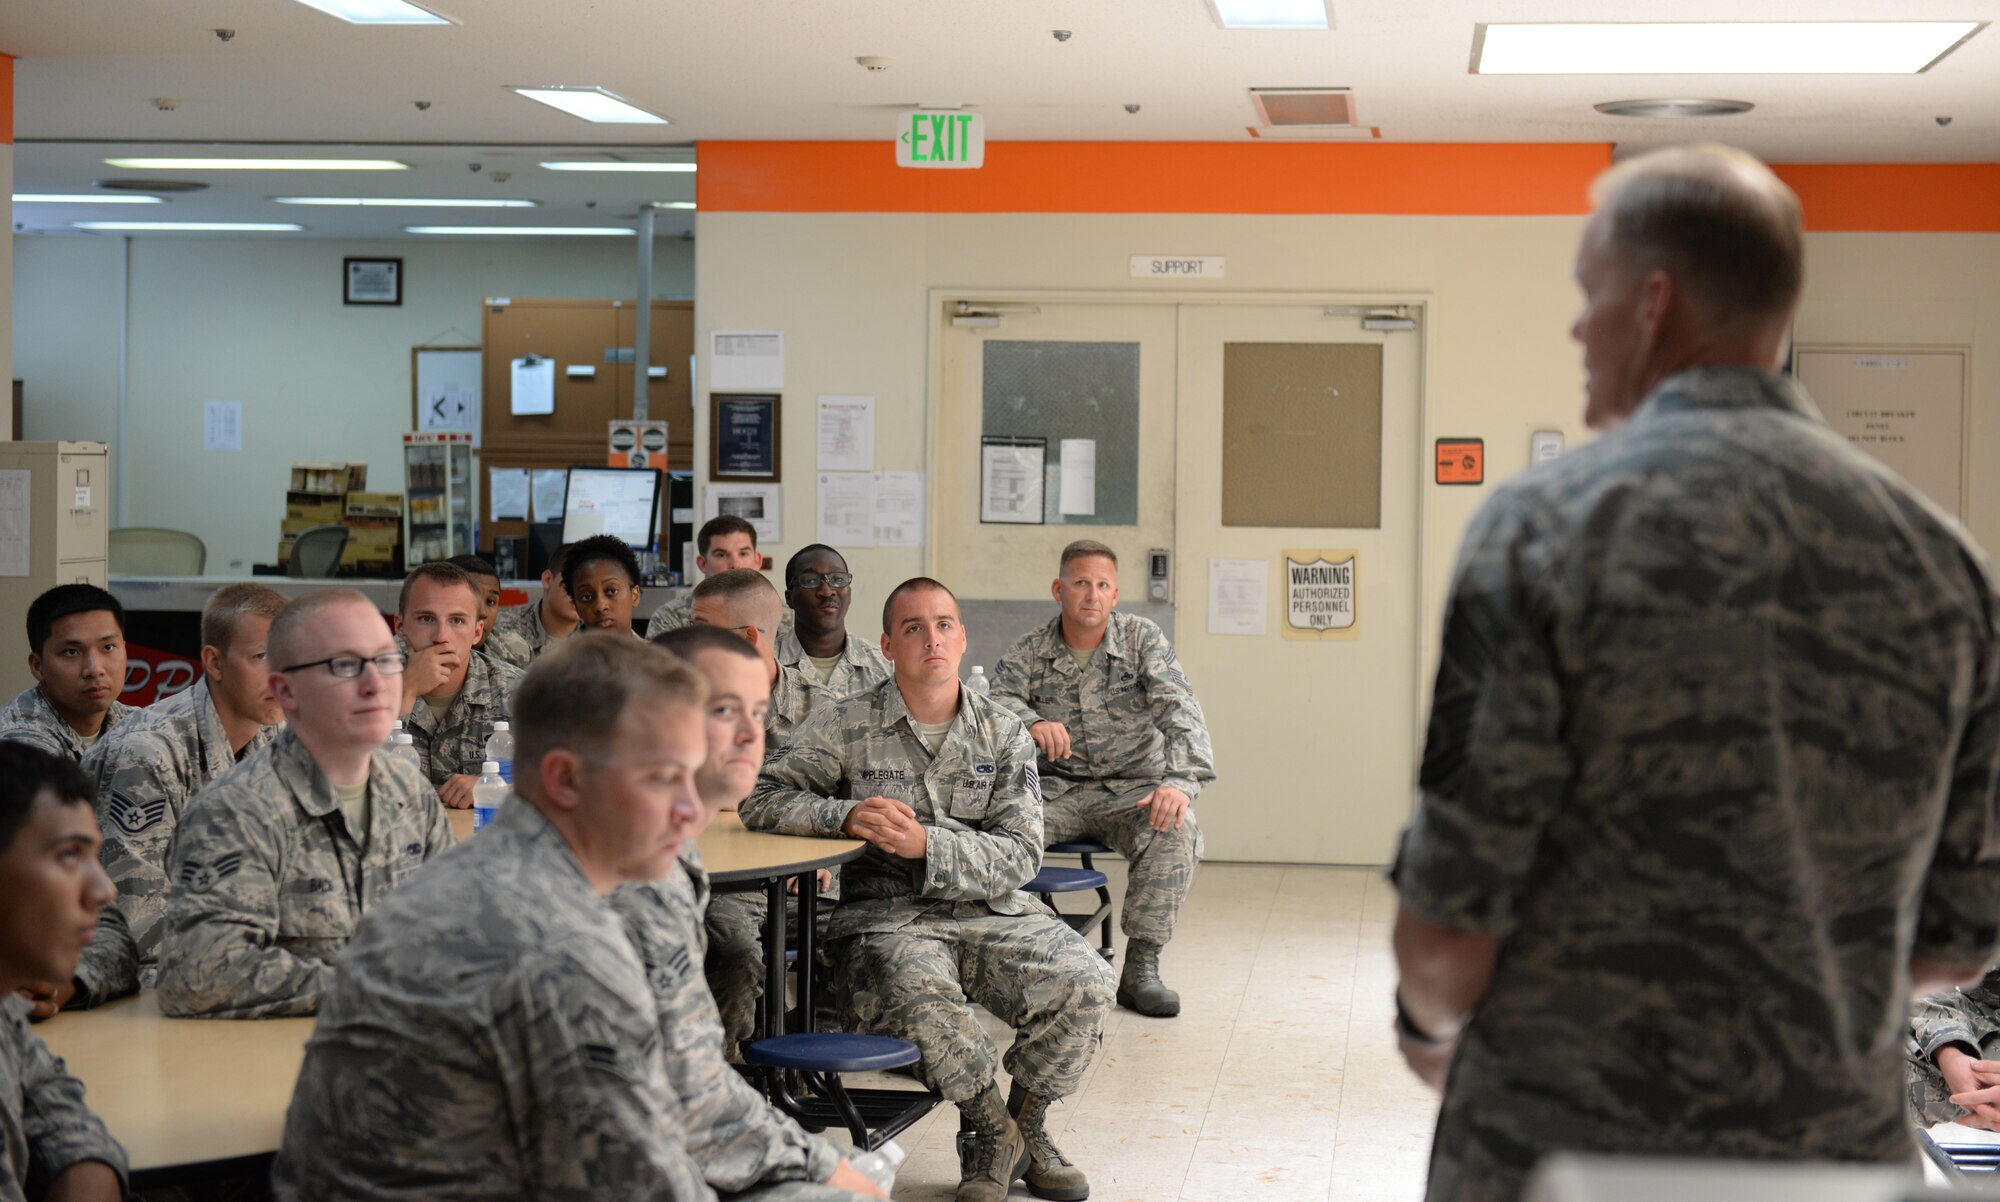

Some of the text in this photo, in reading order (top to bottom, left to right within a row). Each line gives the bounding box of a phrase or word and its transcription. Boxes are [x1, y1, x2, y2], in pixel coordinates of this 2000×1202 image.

[911, 114, 973, 162] EXIT
[1151, 260, 1204, 274] SUPPORT
[1291, 566, 1350, 585] WARNING
[1292, 587, 1350, 600] AUTHORIZED
[1293, 600, 1350, 613] PERSONNEL
[1309, 614, 1334, 627] ONLY
